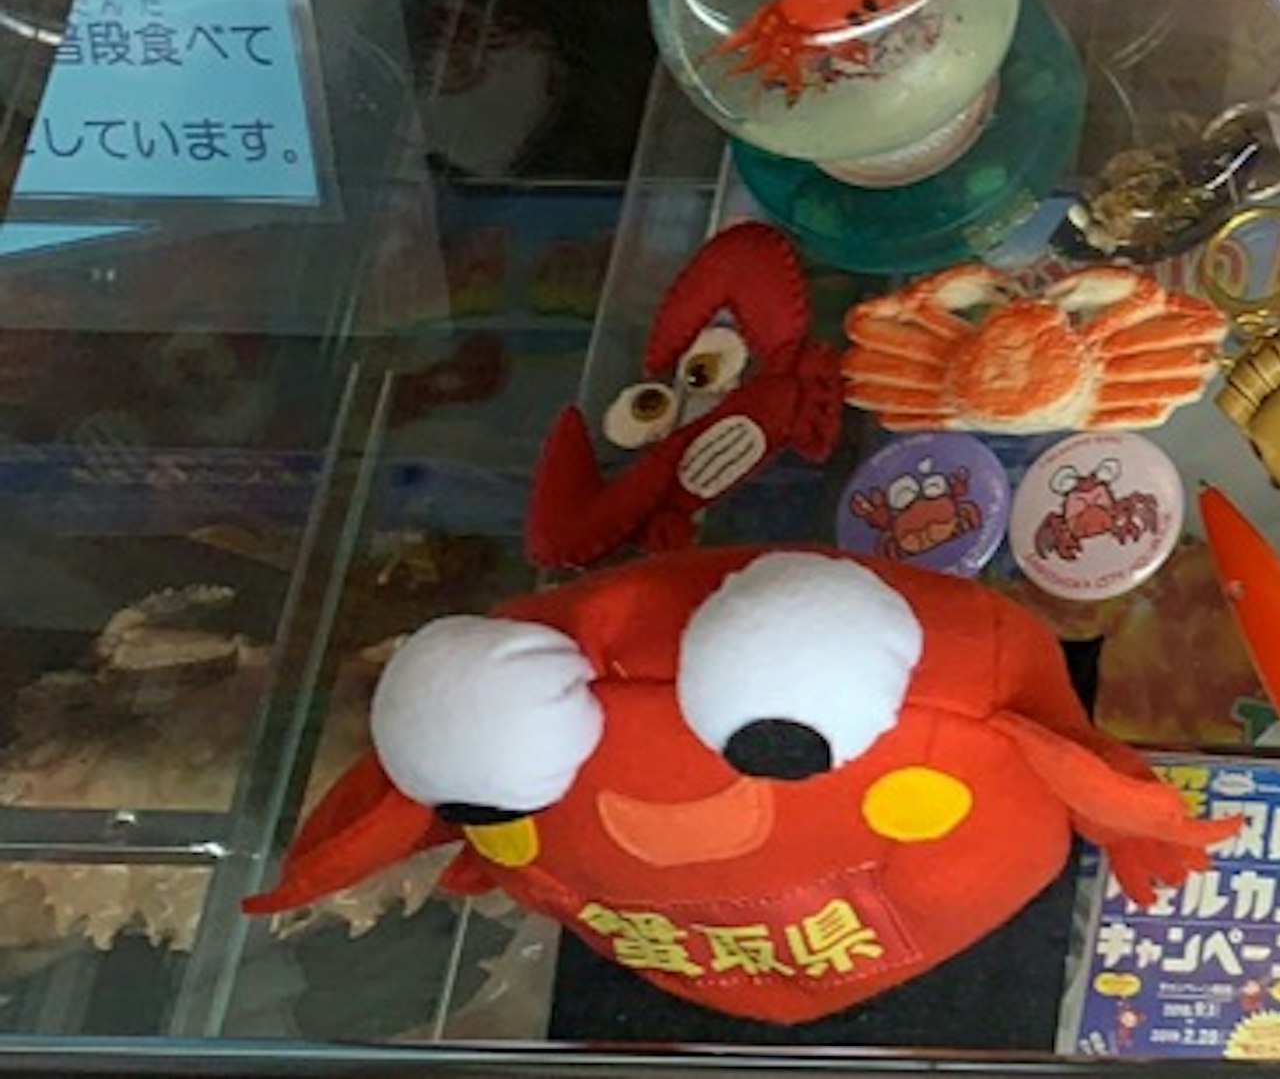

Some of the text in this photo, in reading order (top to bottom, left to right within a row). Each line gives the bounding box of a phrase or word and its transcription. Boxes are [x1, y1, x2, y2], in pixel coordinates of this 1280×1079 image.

[28, 120, 300, 165] しています。
[576, 898, 884, 978] 蟹取県
